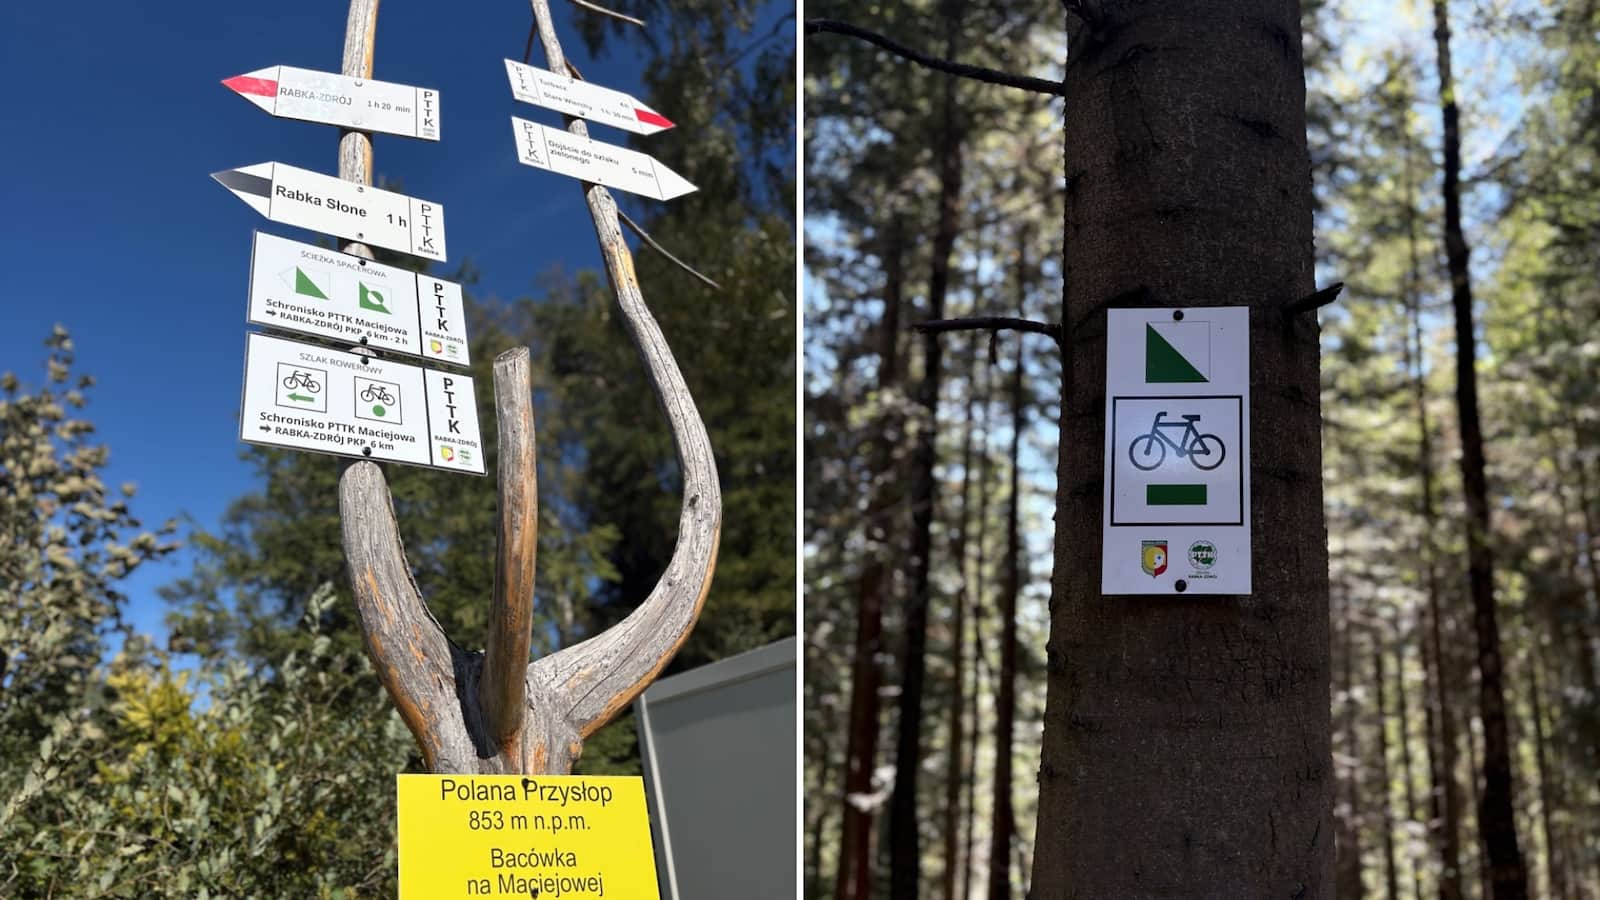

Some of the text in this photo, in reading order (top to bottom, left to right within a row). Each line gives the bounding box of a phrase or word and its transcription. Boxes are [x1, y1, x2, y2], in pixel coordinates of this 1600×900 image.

[279, 87, 411, 113] RABKA-ZDRÓJ 1 h 20 min
[424, 91, 434, 128] PTTK
[523, 122, 538, 159] PTTK
[548, 140, 619, 165] Dojście do szlaku
[550, 149, 591, 165] zielonego
[638, 168, 654, 178] min
[275, 184, 407, 228] Rabka Słone 1 h
[421, 203, 434, 249] PTTK
[301, 249, 387, 278] ŚCIEŻKA SPACEROWA
[418, 246, 440, 256] Rabka
[265, 298, 408, 336] Schronisko PTTK Maciejowa
[434, 282, 448, 332] PTTK
[280, 311, 343, 333] RABKA-ZDRÓJ
[345, 325, 362, 336] PKP
[366, 329, 372, 338] 6
[374, 331, 388, 342] km
[395, 335, 400, 344] 2
[402, 335, 408, 346] h
[425, 331, 464, 345] RABKA-ZDRÓJ
[299, 352, 384, 376] SZLAK ROWEROWY
[443, 377, 460, 434] PTTK
[260, 411, 416, 444] Schronisko PTTK Maciejowa
[275, 426, 394, 451] RABKA-ZDRÓJ PKP 6 km
[434, 435, 478, 449] RABKA-ZDRÓJ
[441, 779, 613, 807] Polana Przysłop
[469, 810, 591, 834] 853 m n.p.m.
[490, 847, 577, 868] Bacówka
[467, 872, 604, 898] na Maciejowej
